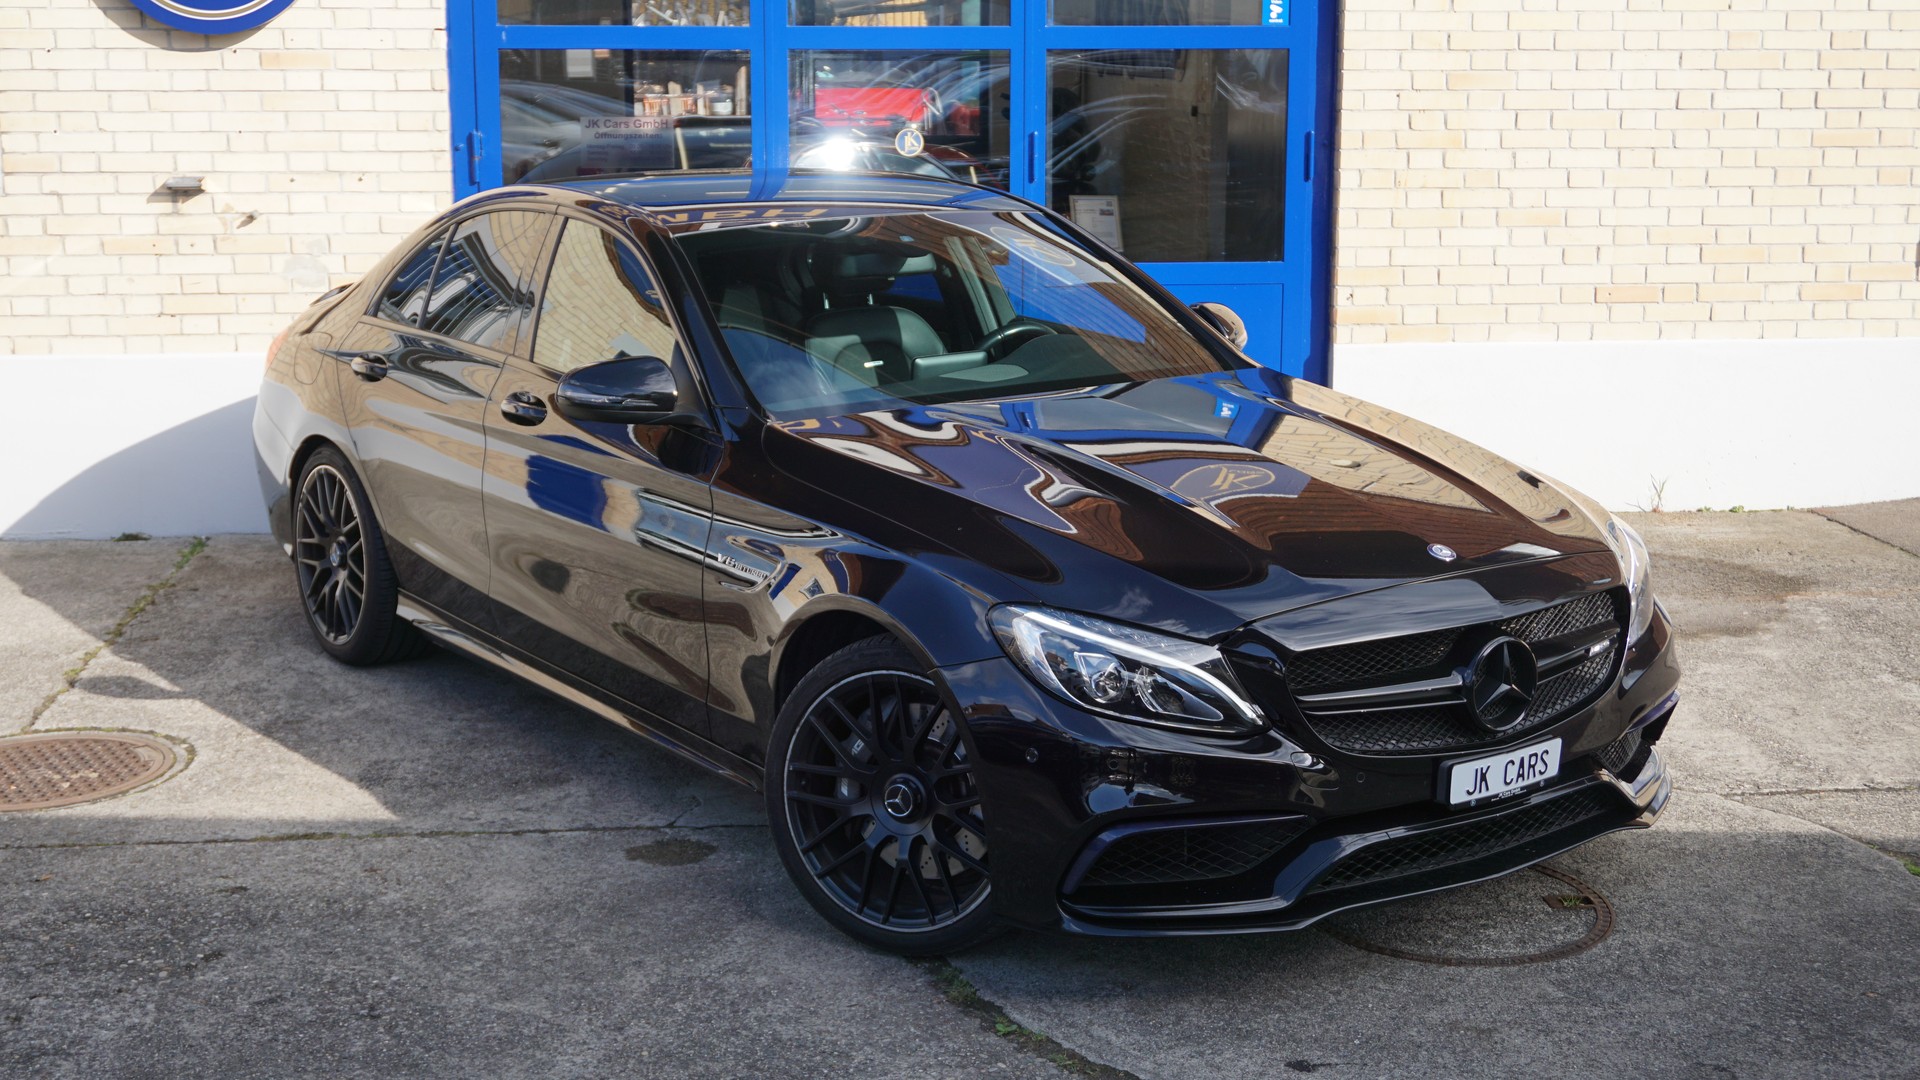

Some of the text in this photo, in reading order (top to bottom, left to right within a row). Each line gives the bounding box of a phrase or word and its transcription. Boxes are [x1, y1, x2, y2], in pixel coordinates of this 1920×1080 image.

[584, 118, 668, 129] JK Cars GmbH
[1466, 749, 1549, 796] JK CARS
